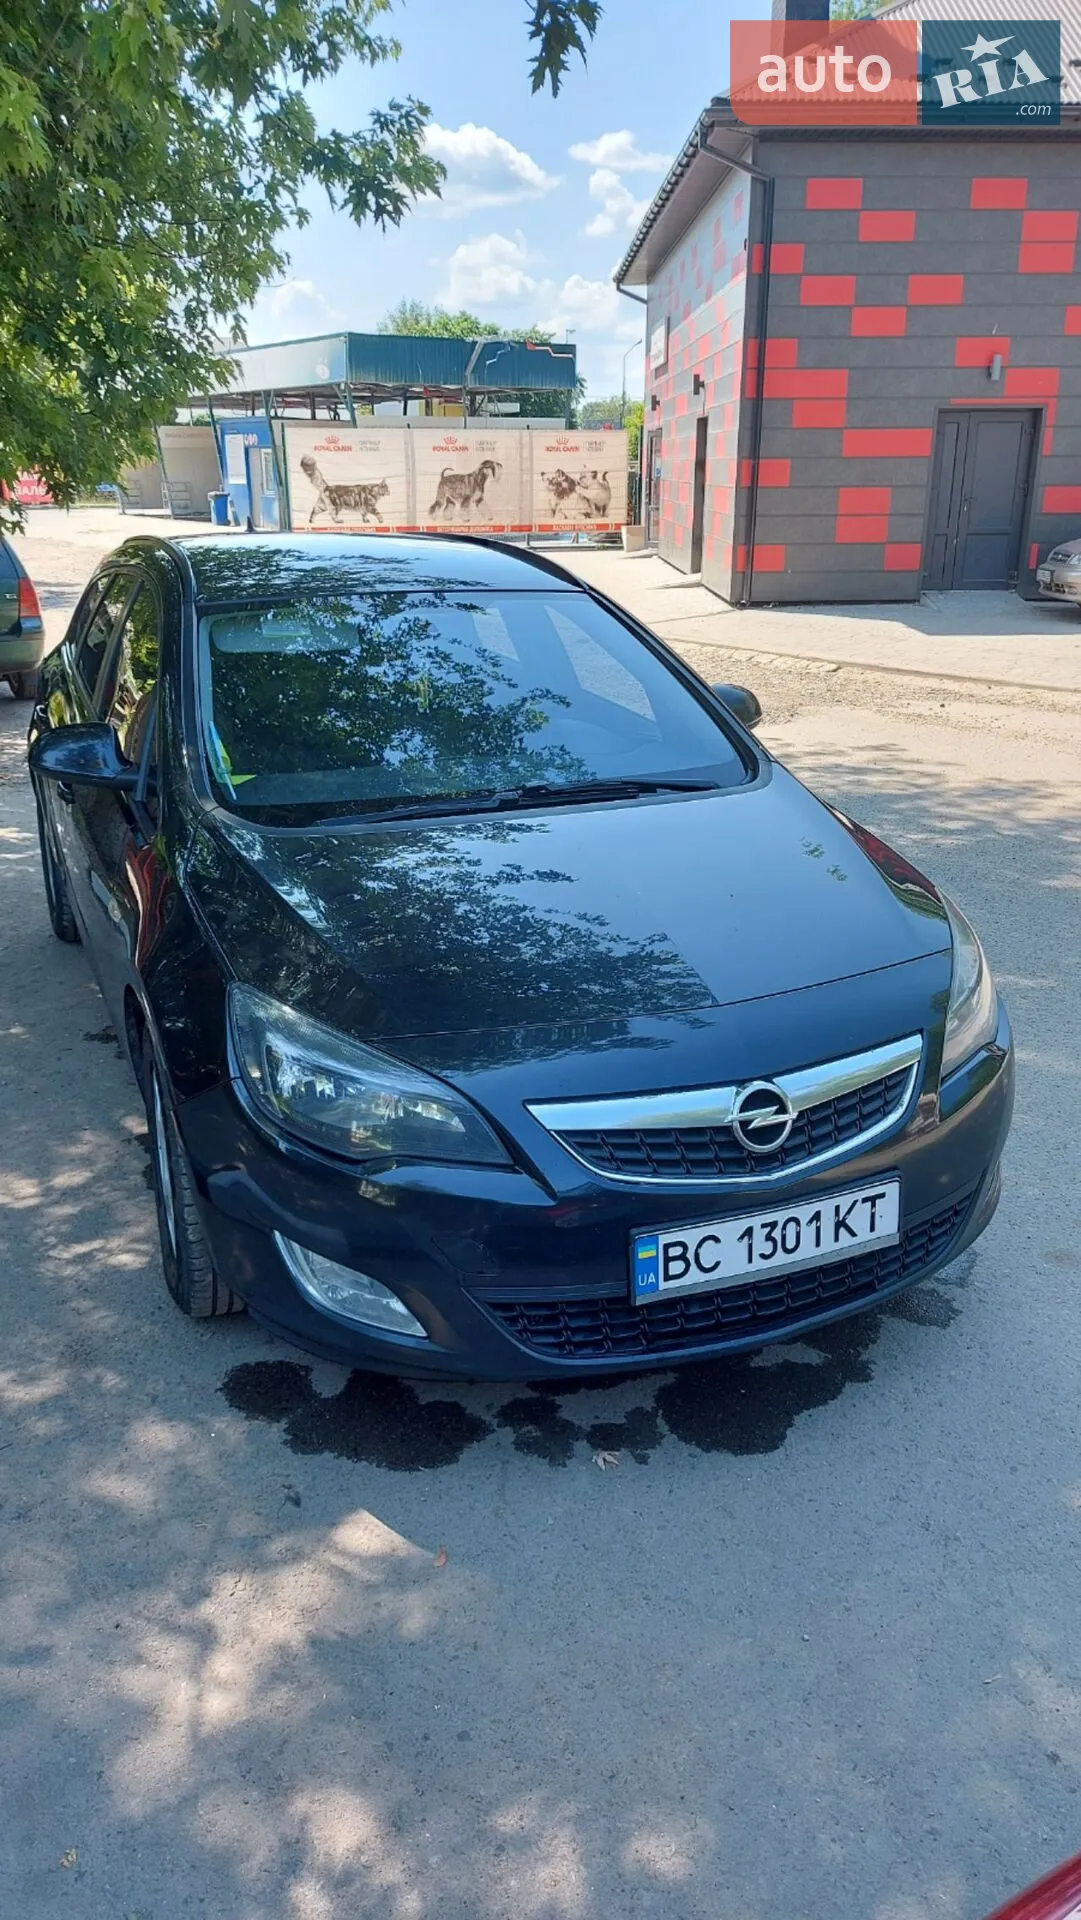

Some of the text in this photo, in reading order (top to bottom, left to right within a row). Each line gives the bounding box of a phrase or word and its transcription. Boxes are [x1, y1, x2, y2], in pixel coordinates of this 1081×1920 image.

[663, 1192, 886, 1283] BC 1301 KT
[638, 1272, 656, 1287] UA
